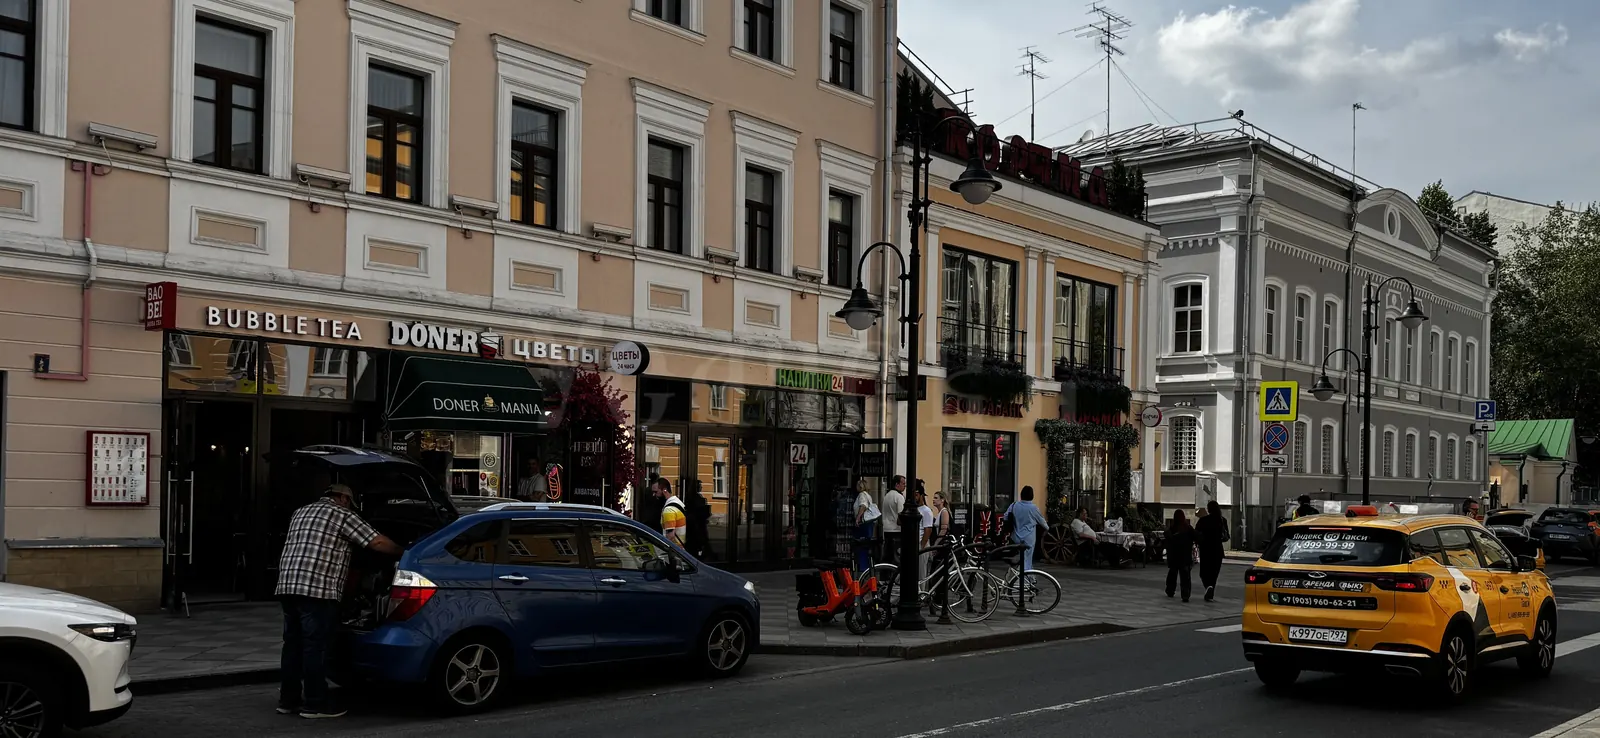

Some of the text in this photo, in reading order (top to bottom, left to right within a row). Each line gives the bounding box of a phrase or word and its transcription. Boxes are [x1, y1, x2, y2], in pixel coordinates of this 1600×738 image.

[147, 285, 164, 301] BAO
[147, 300, 163, 319] BEI
[207, 306, 362, 340] BUBBLE TEA
[513, 338, 600, 364] ЦВЕТЫ
[612, 349, 639, 361] ЦВЕТЫ
[779, 368, 832, 391] НАПИТКИ
[832, 375, 843, 389] 24
[432, 397, 542, 415] DONER MANIA
[1478, 403, 1490, 418] P
[792, 446, 806, 463] 24
[1292, 533, 1323, 541] Яндекс
[1341, 533, 1369, 541] Такси
[1303, 541, 1355, 550] 999-99-99
[1292, 596, 1312, 605] (903)
[1313, 598, 1356, 607] 960-62-21
